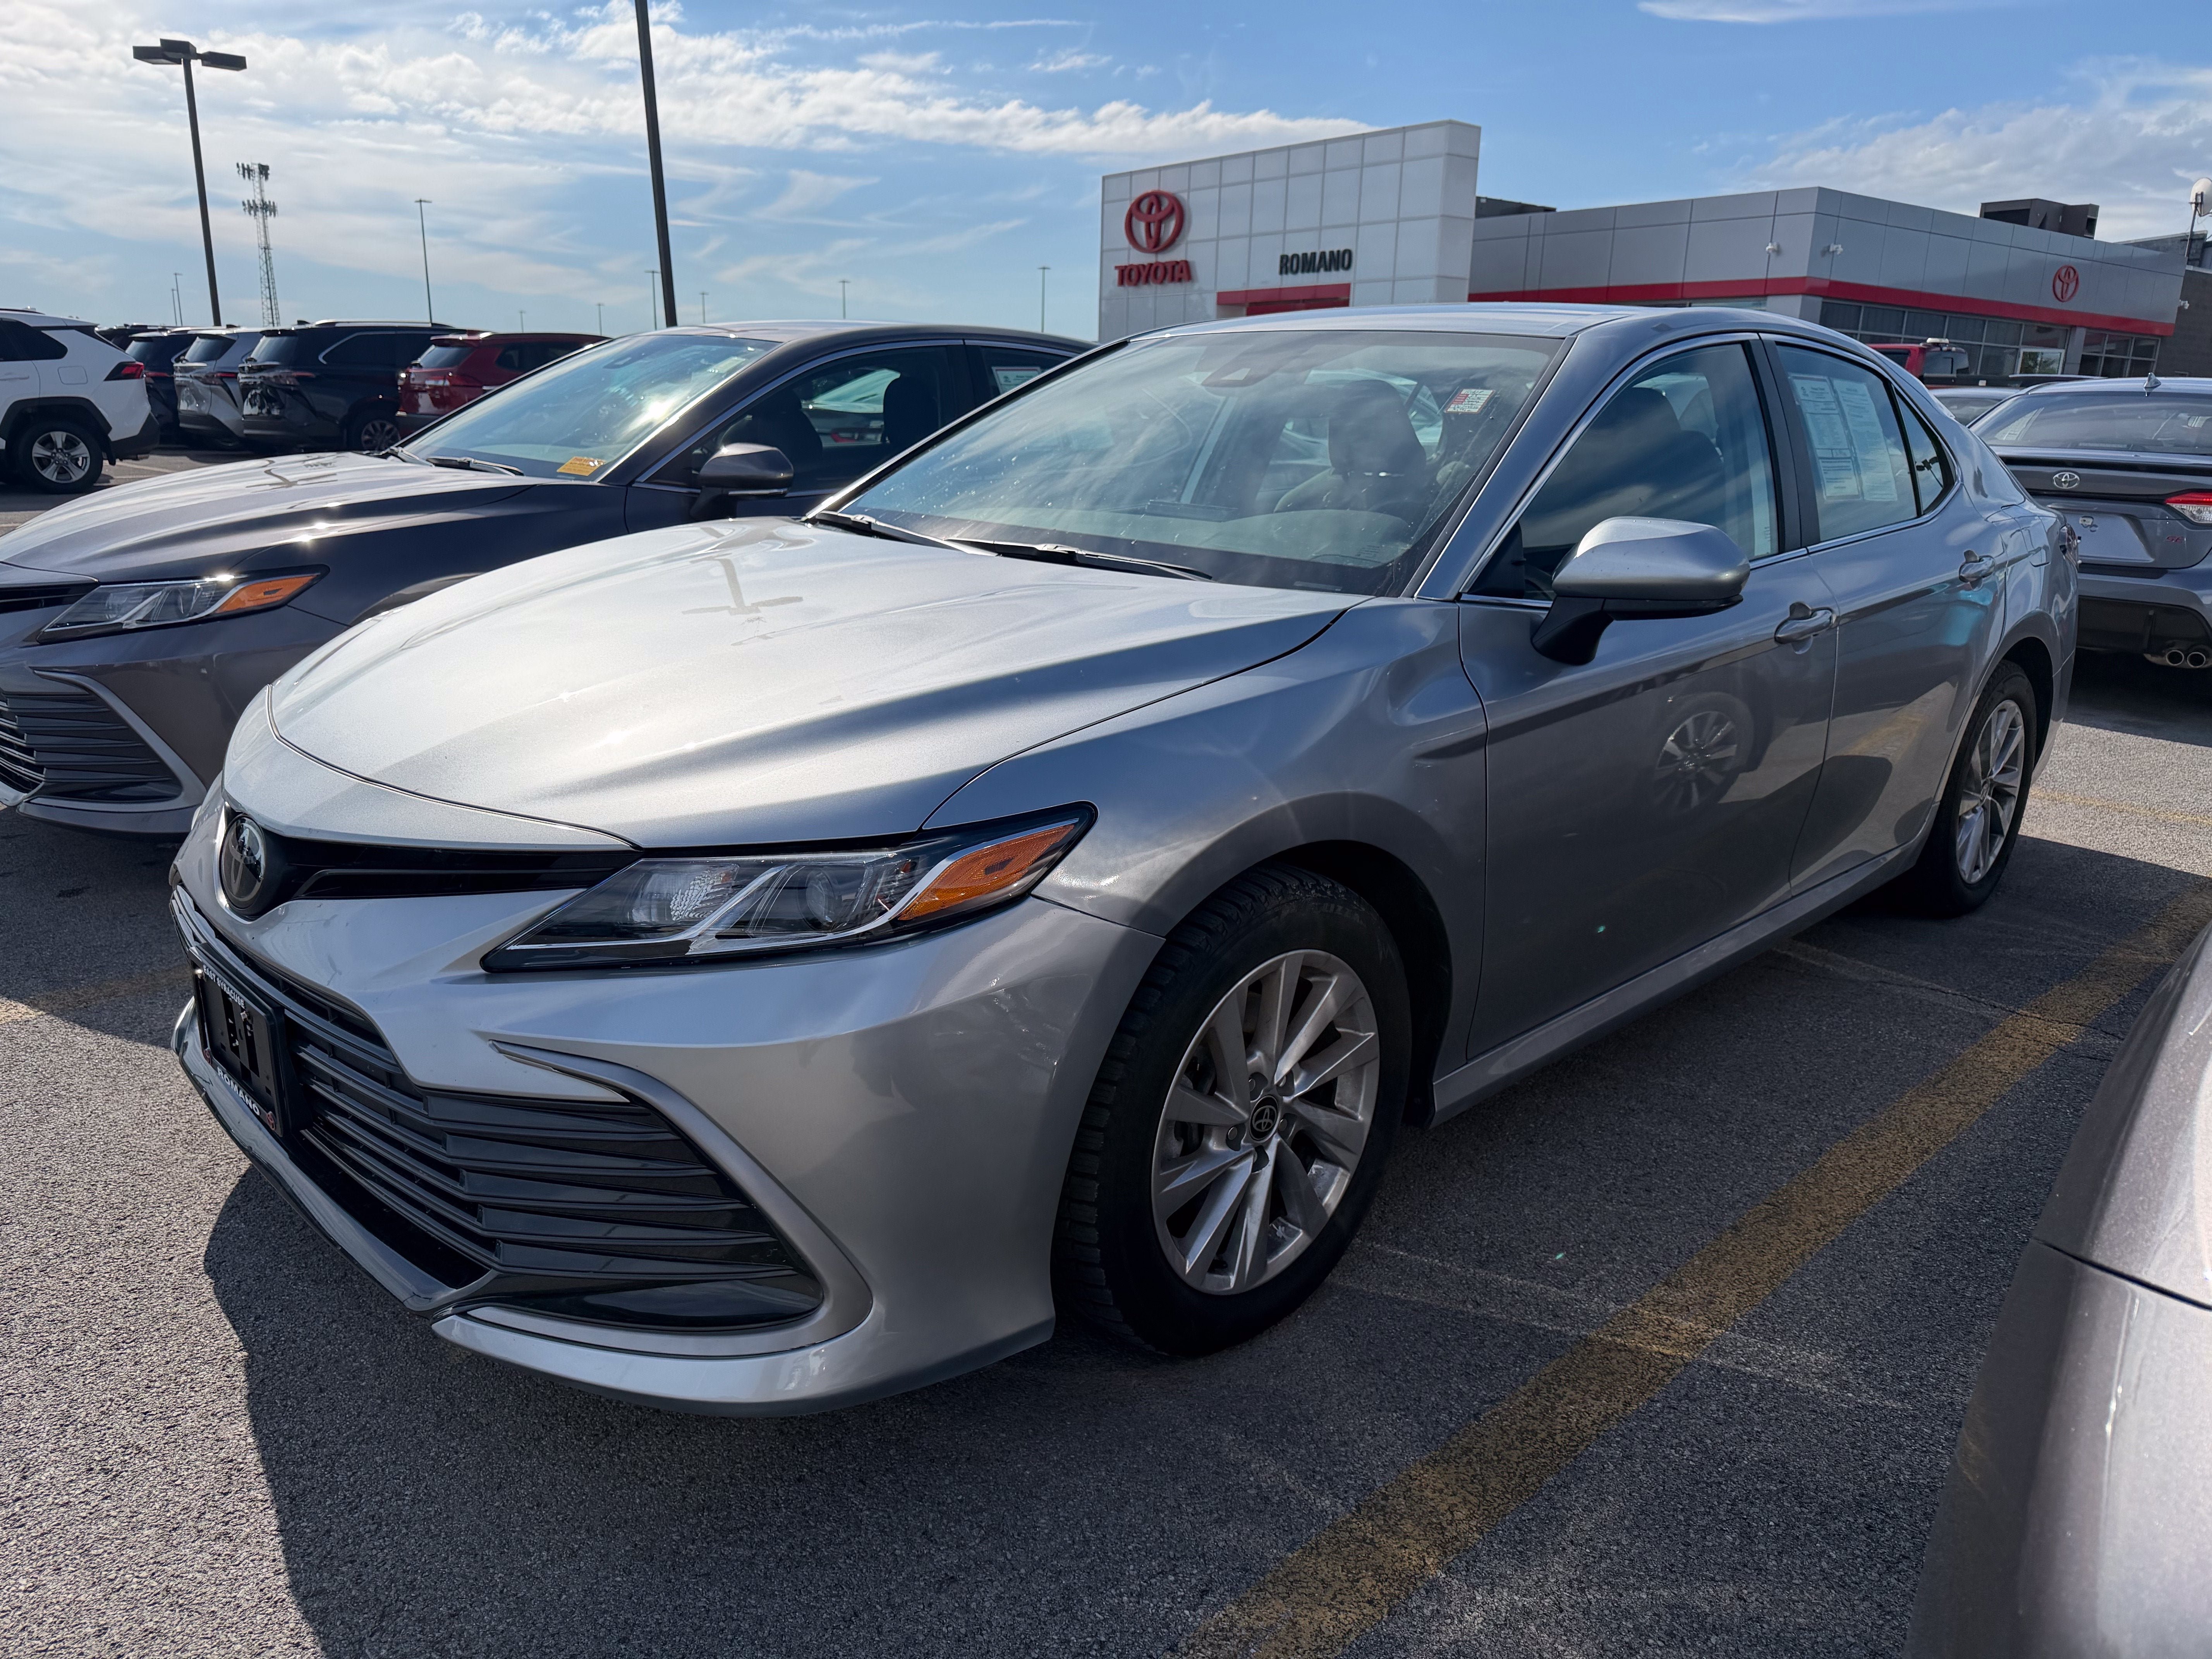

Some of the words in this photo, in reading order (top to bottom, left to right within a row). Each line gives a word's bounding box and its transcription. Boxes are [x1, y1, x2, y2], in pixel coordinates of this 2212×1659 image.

[1114, 260, 1192, 287] TOYOTA
[1279, 249, 1352, 275] ROMANO
[203, 965, 216, 982] EAST
[217, 977, 245, 1009] SYRACUSE
[217, 1066, 260, 1116] ROMANO
